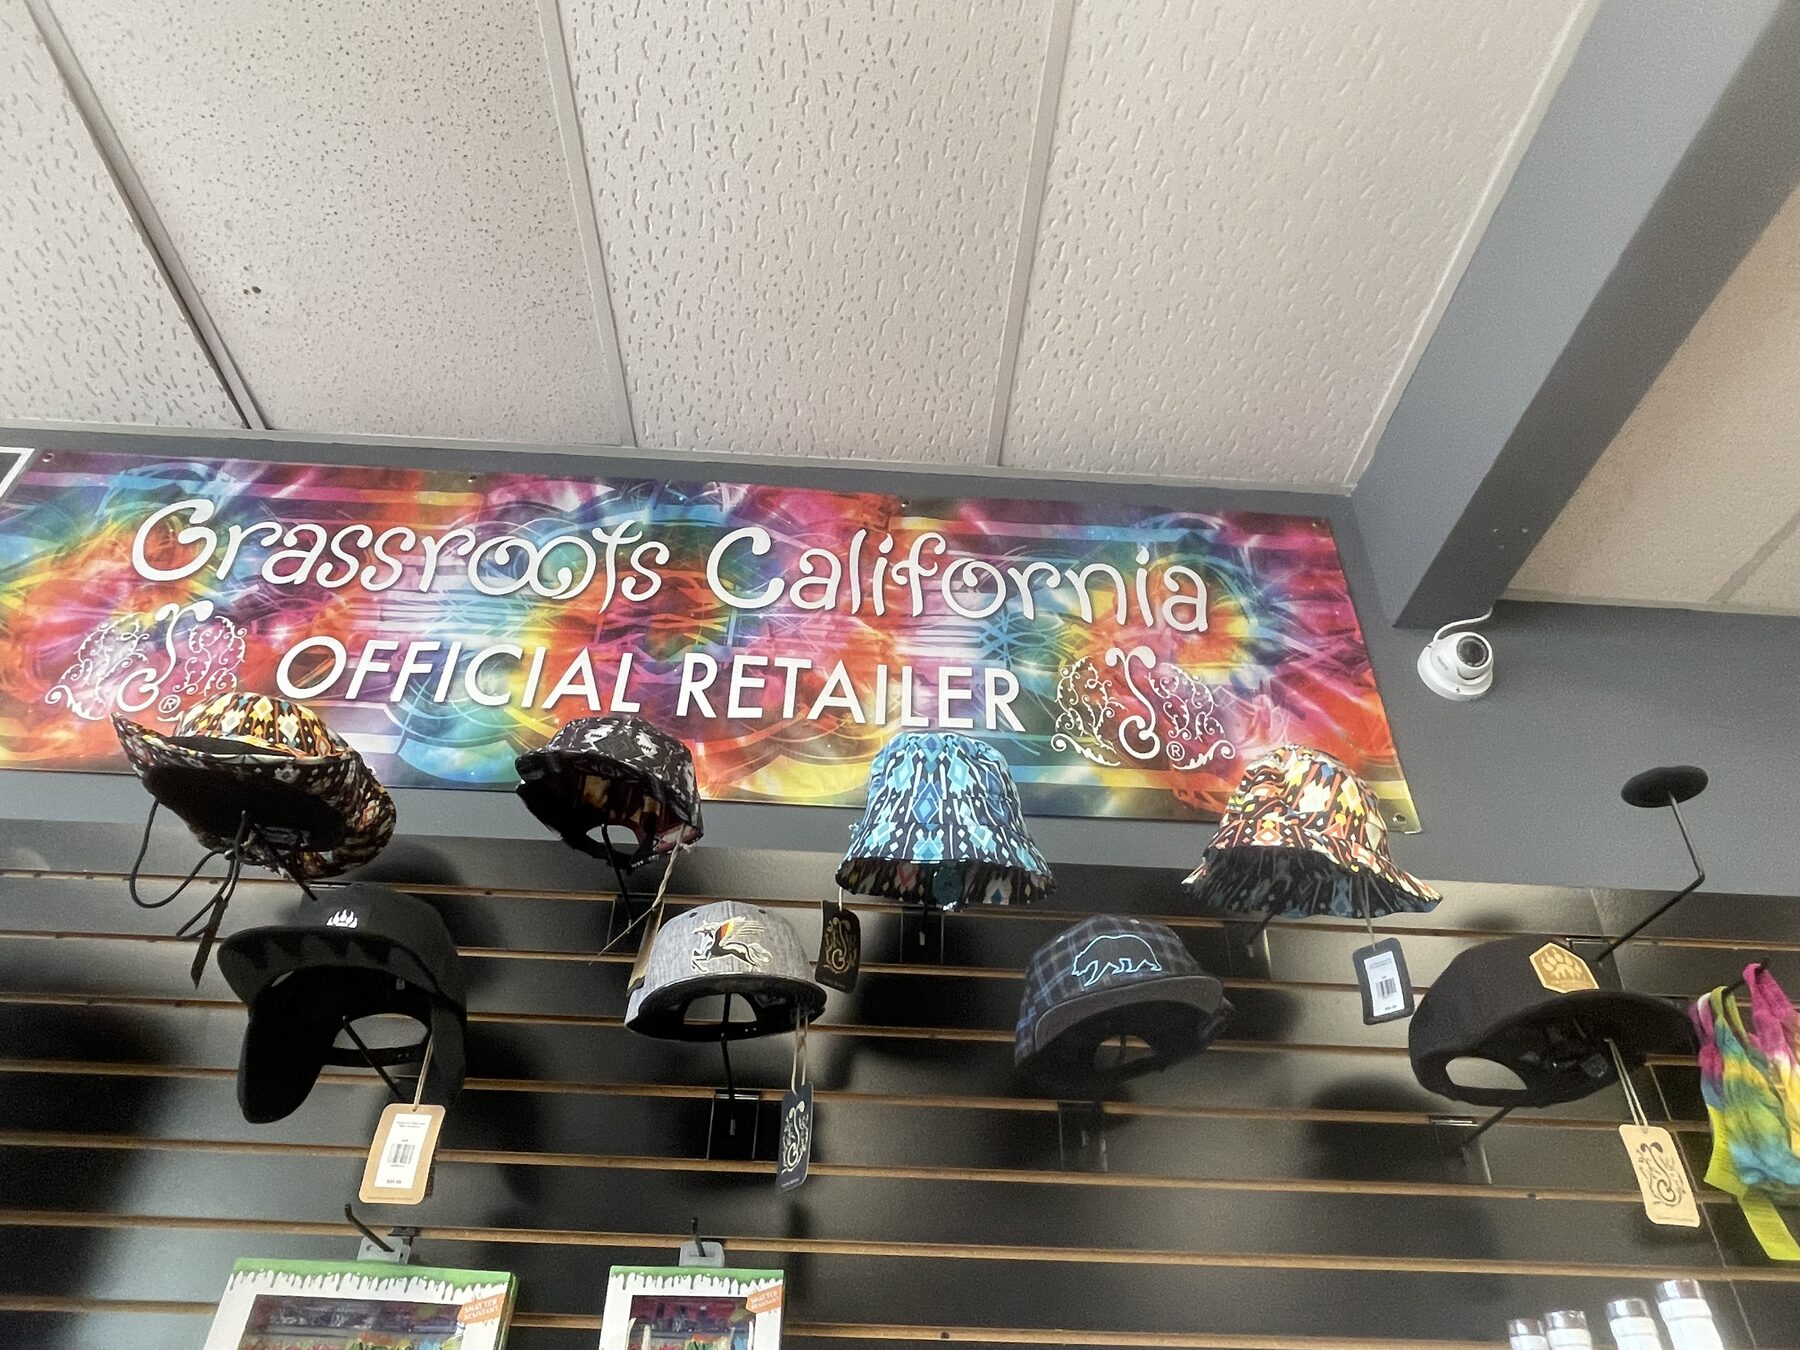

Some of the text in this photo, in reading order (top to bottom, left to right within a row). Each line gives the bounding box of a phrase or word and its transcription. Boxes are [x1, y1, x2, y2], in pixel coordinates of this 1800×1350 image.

[131, 498, 1209, 633] Grassroots California
[274, 635, 1026, 733] OFFICIAL RETAILER
